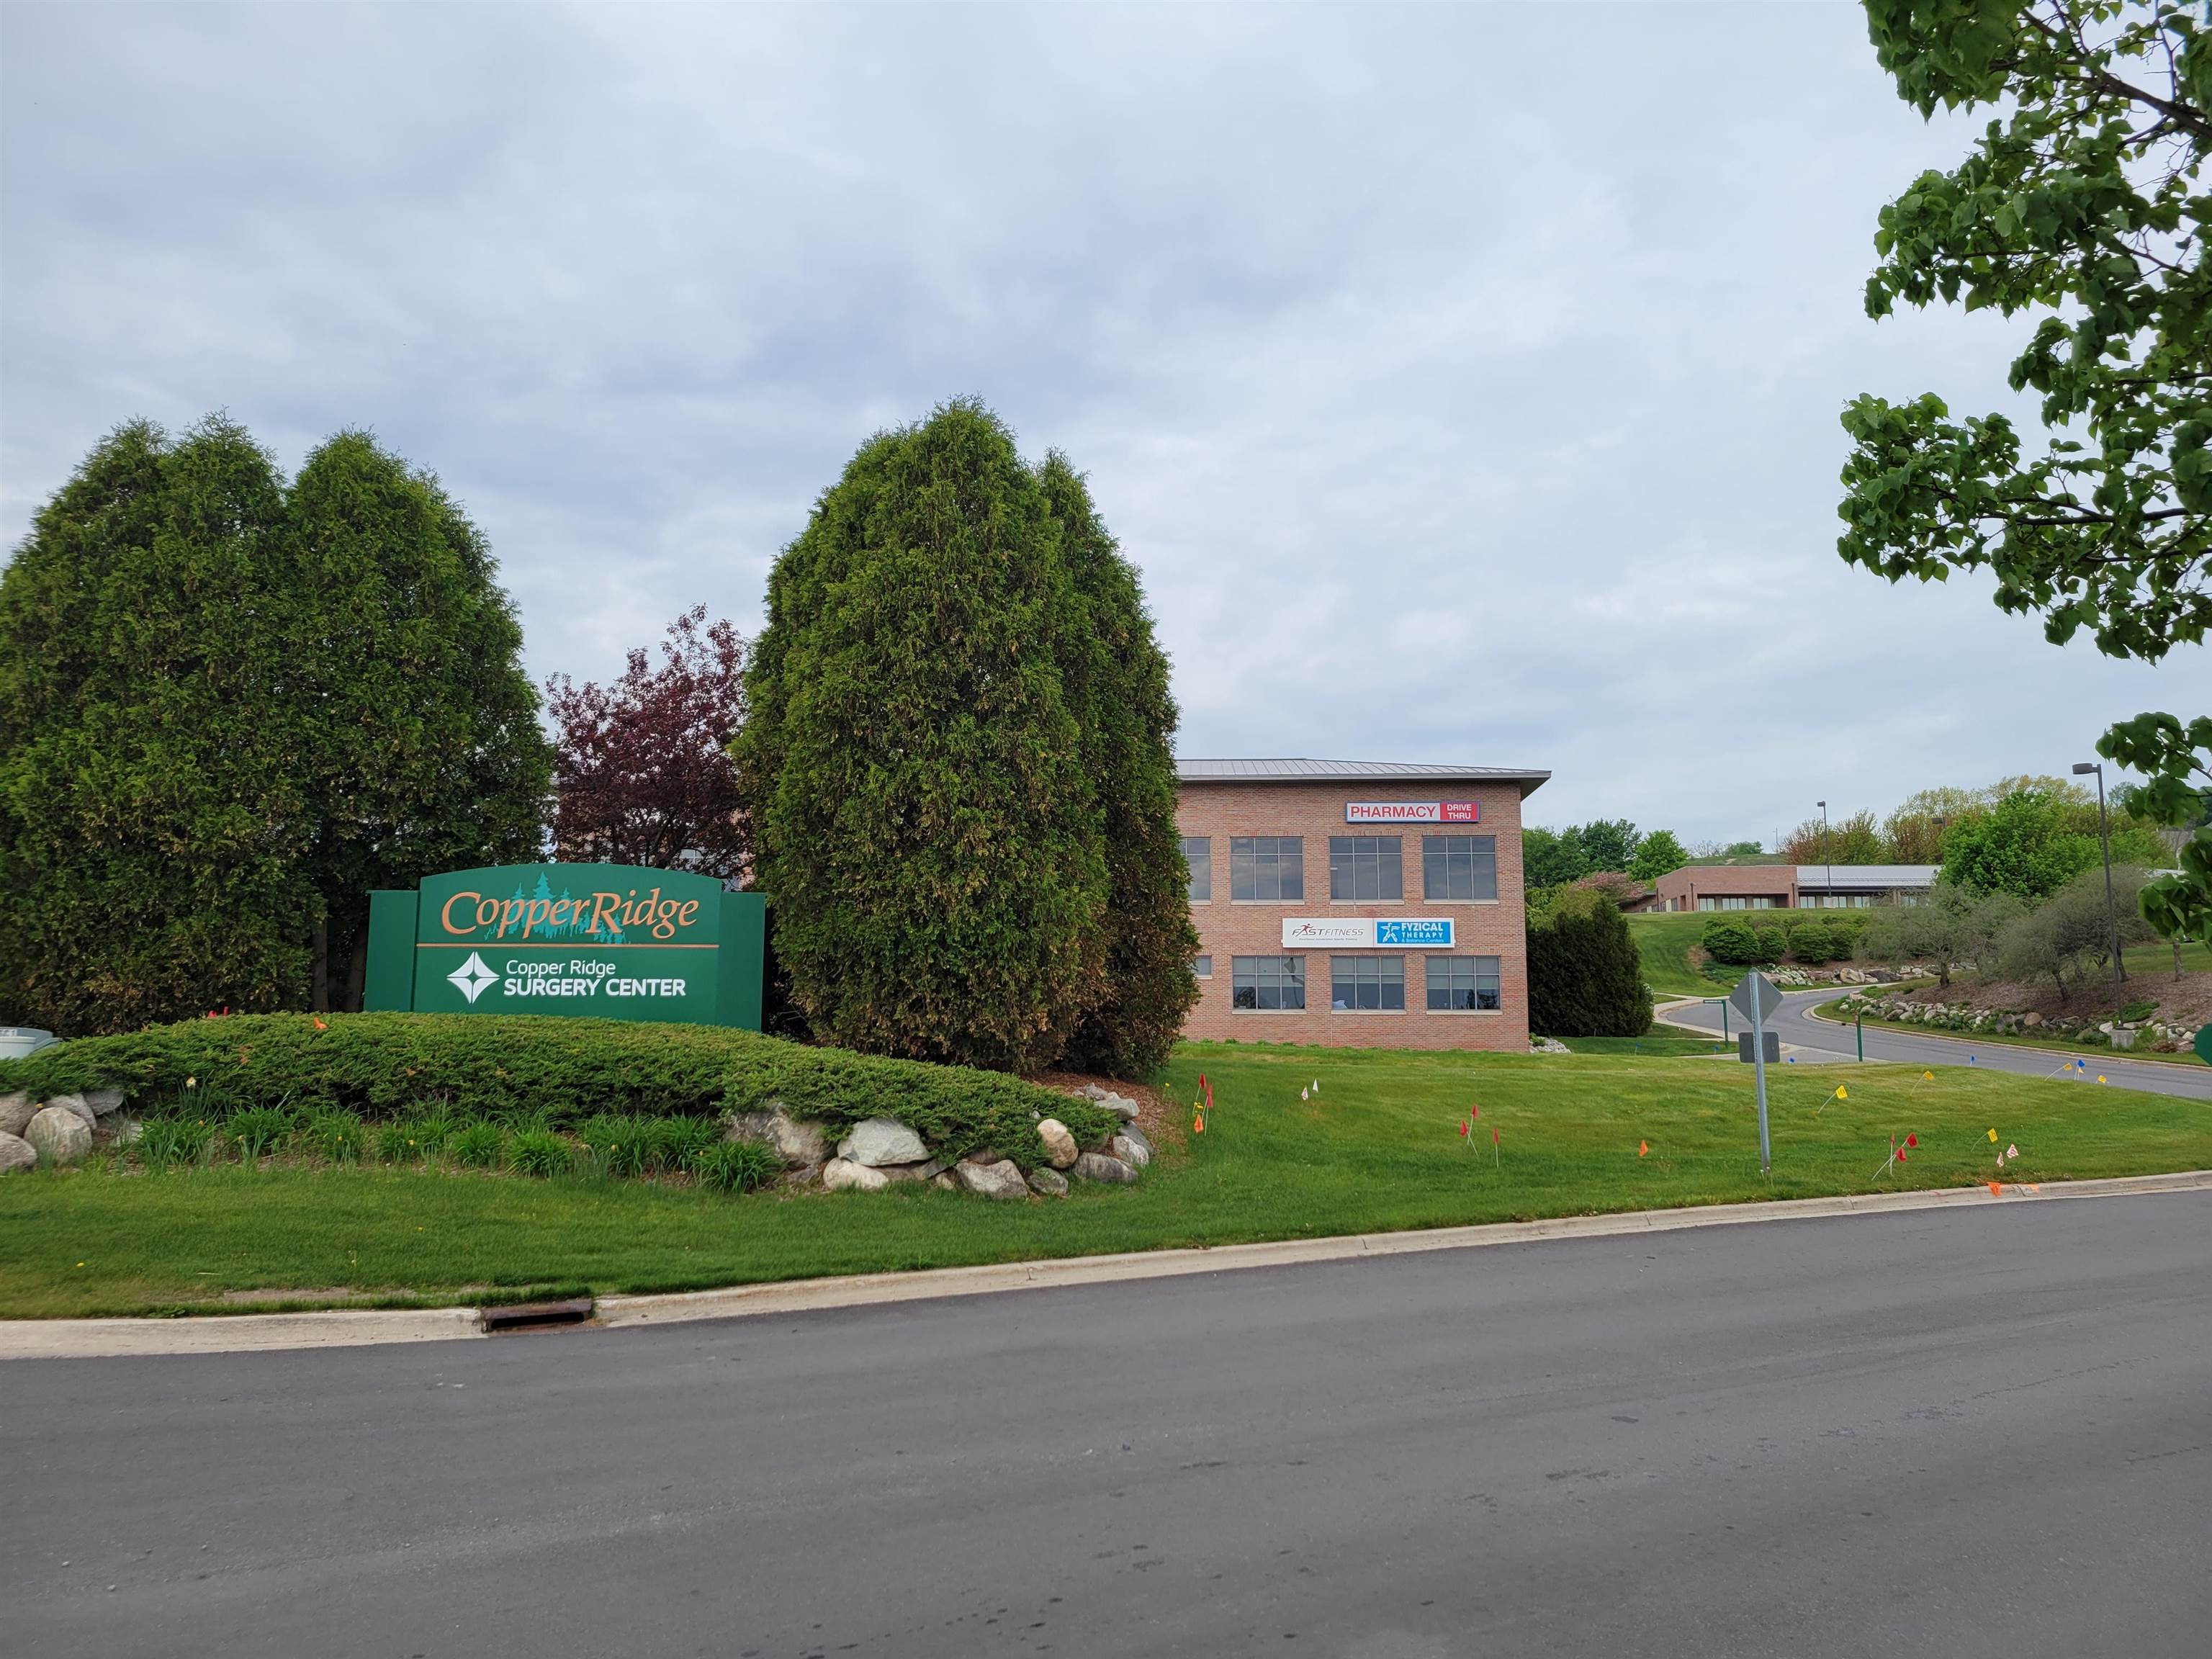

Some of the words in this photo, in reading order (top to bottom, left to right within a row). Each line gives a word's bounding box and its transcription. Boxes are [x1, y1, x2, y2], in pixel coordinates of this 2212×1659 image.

[1351, 806, 1436, 818] PHARMACY
[1401, 922, 1444, 931] FYZICAL
[506, 960, 565, 978] Copper
[570, 960, 616, 978] Ridge
[504, 979, 601, 996] SURGERY
[606, 979, 686, 996] CENTER
